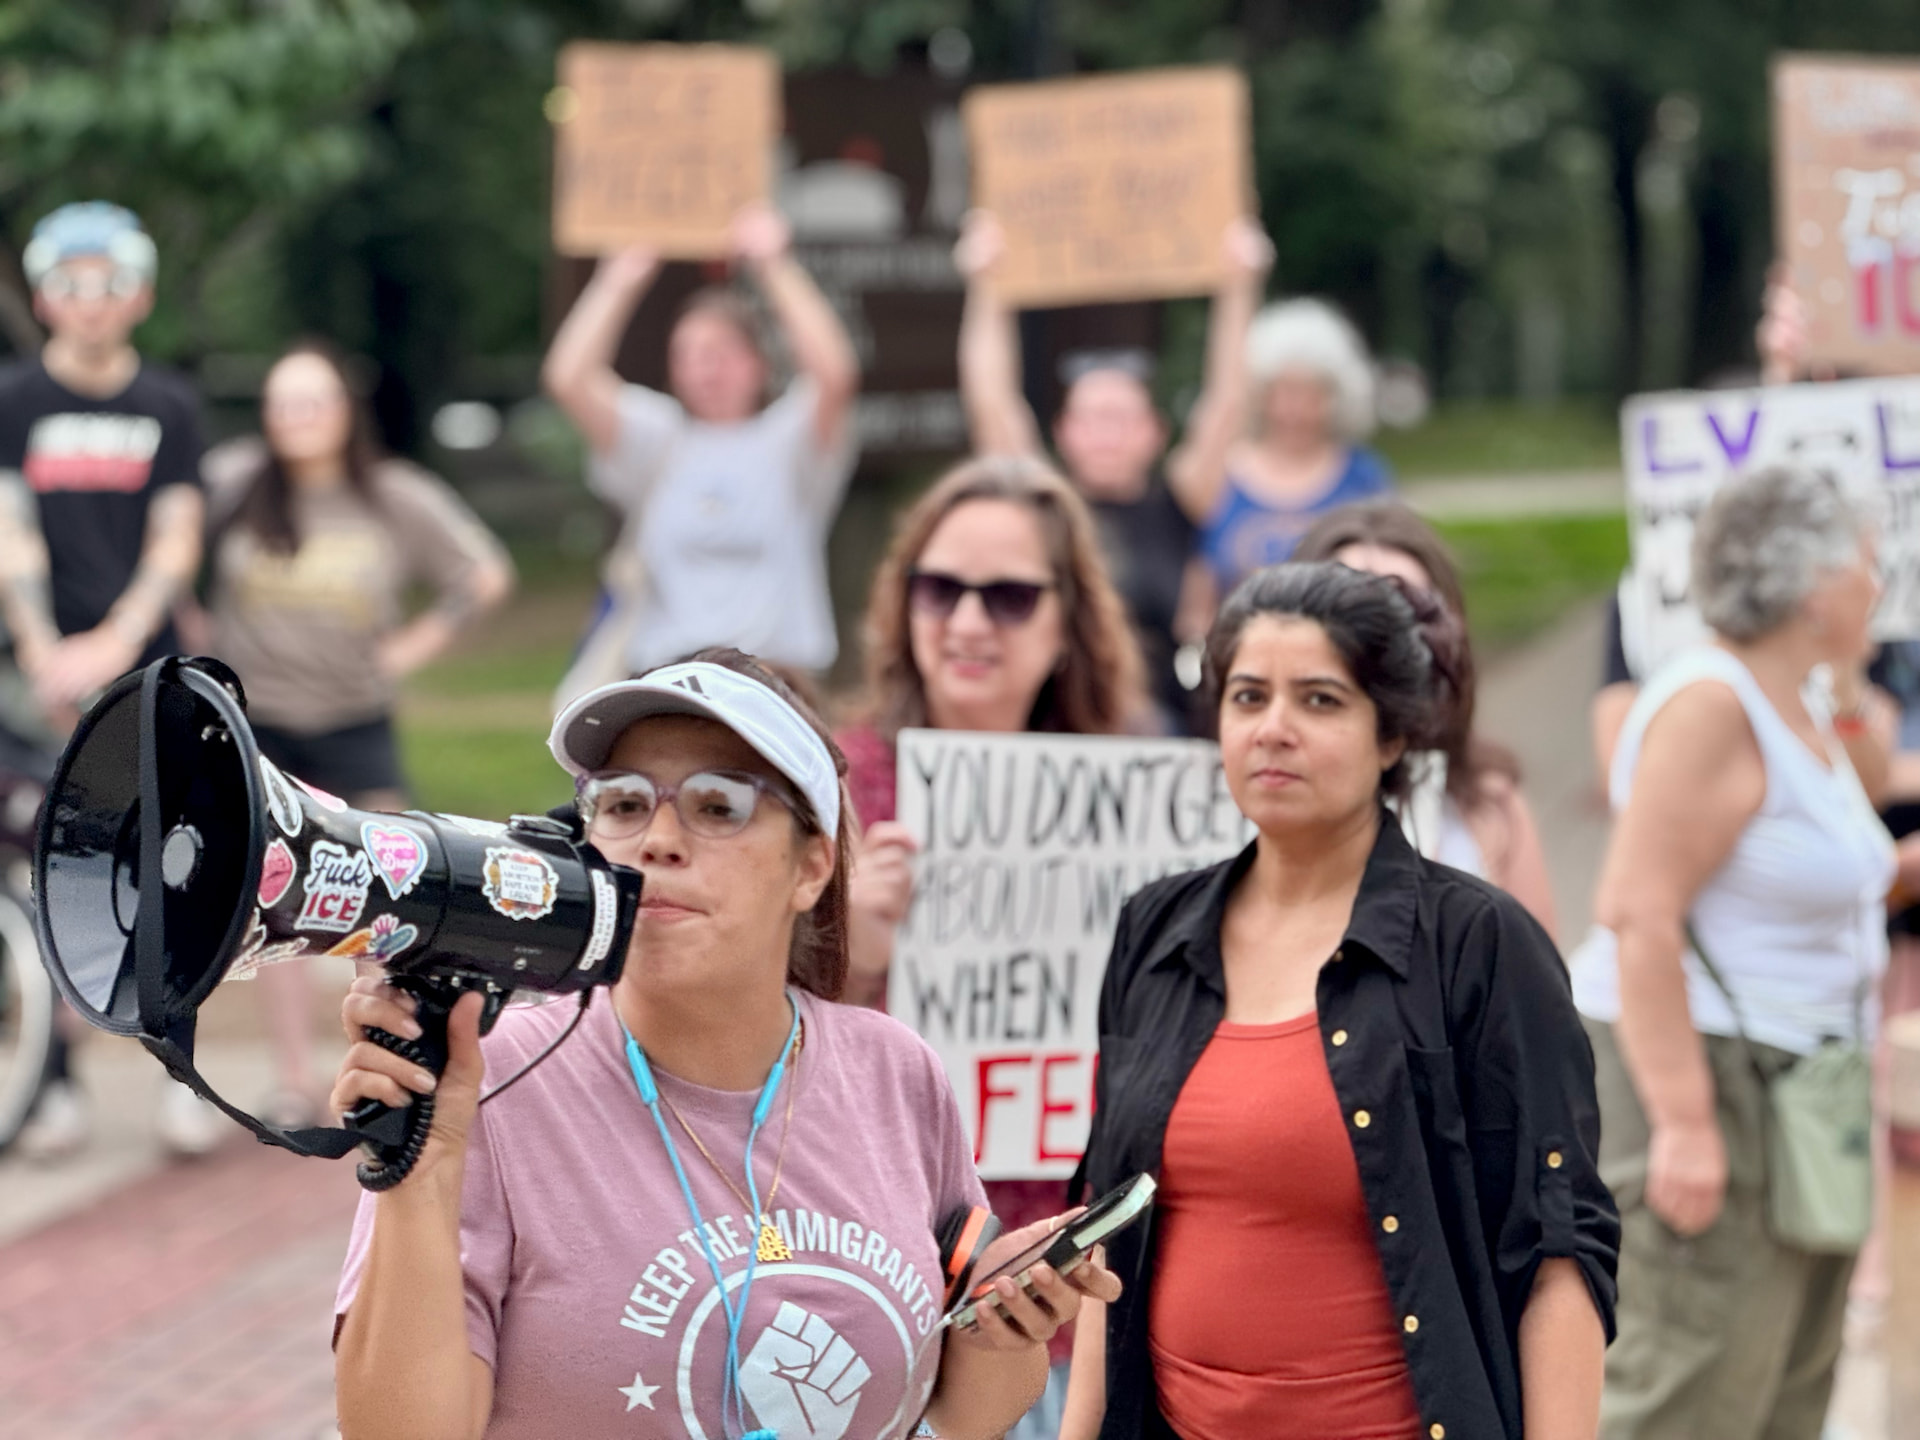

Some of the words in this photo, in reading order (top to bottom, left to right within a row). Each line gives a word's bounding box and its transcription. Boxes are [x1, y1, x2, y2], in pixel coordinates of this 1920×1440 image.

[908, 744, 1018, 851] YOU
[1168, 750, 1246, 850] GE
[305, 890, 362, 921] ICE
[306, 848, 369, 889] Fuck
[906, 952, 1079, 1043] WHEN
[972, 1052, 1100, 1165] FE
[620, 1248, 696, 1338] KEEP
[677, 1215, 750, 1262] THE
